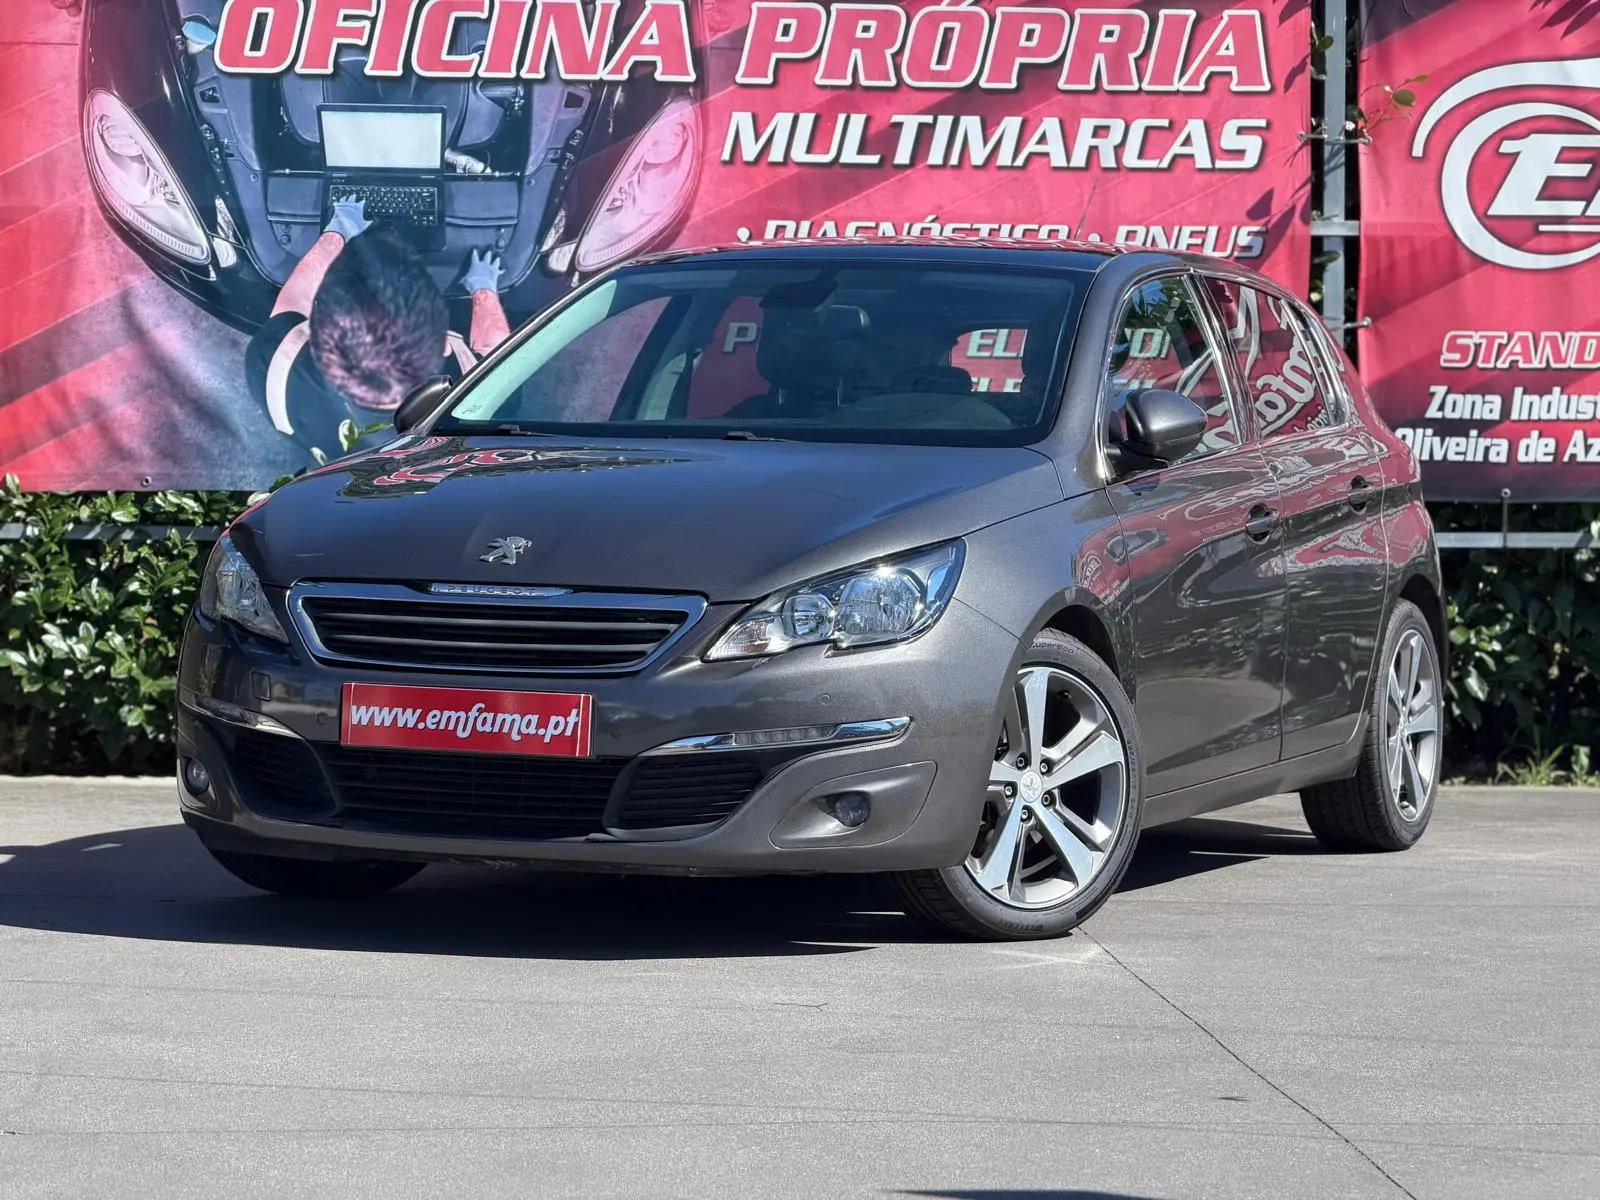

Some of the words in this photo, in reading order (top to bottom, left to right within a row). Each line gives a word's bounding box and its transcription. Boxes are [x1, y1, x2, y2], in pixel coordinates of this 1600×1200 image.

[214, 0, 697, 82] OFICINA
[735, 0, 1273, 92] PRÓPRIA
[720, 110, 1268, 169] MULTIMARCAS
[1440, 330, 1600, 369] STAND
[1425, 385, 1502, 420] Zona
[1517, 430, 1556, 463] de
[447, 585, 536, 596] PEUGEOT
[351, 703, 580, 743] www.emfama.pt
